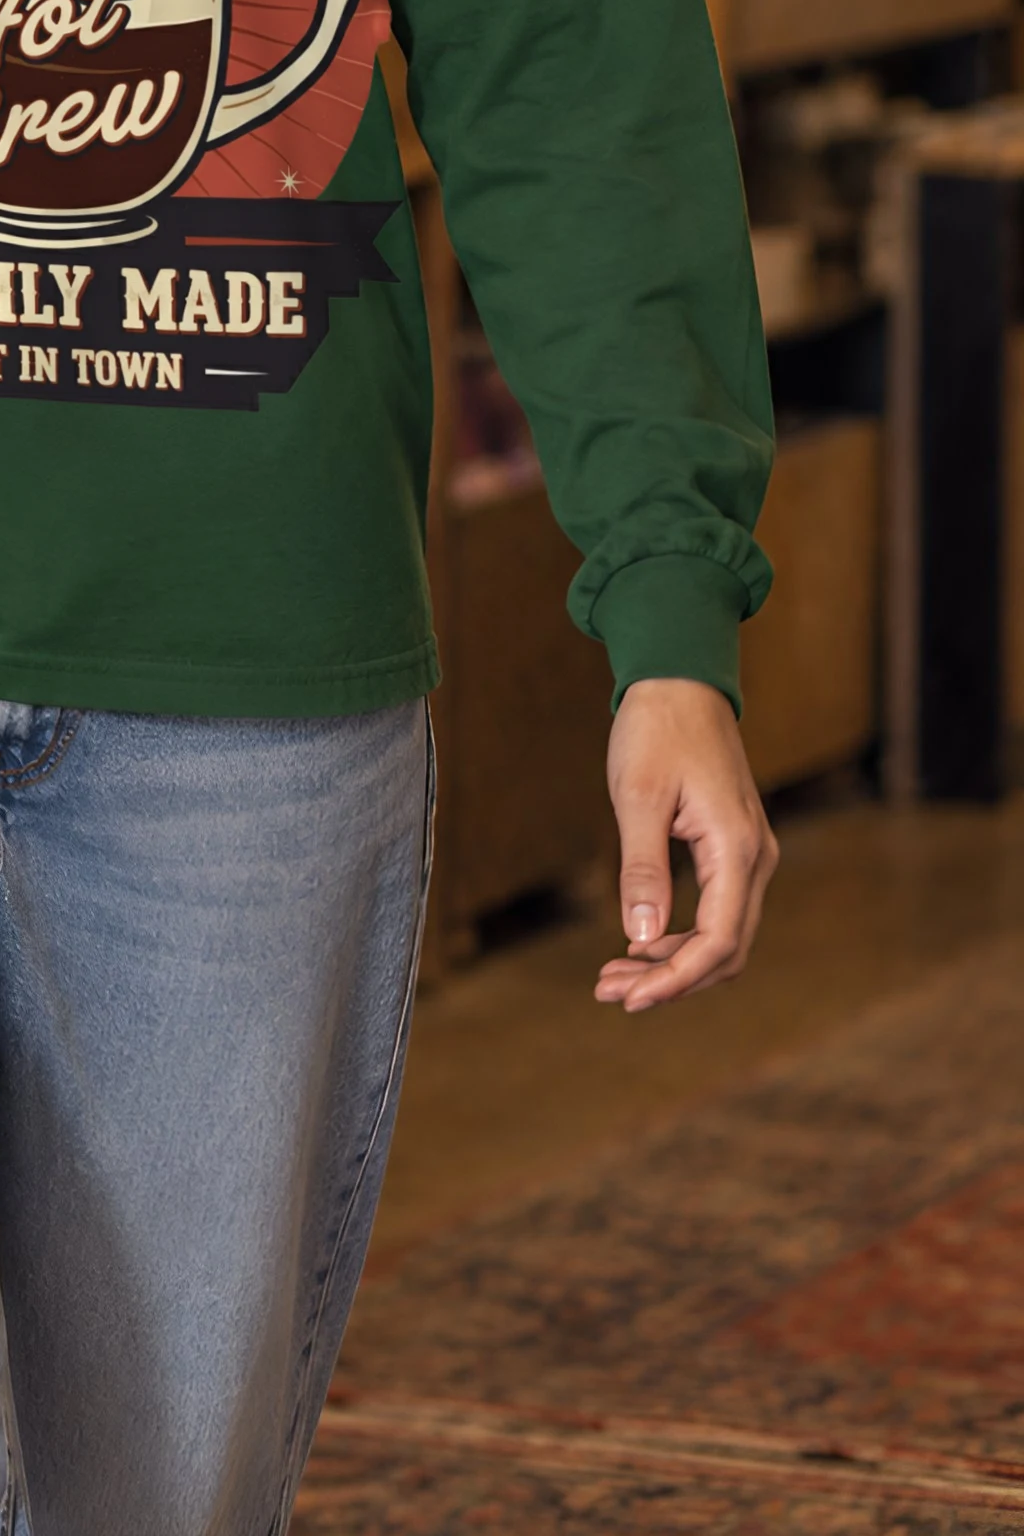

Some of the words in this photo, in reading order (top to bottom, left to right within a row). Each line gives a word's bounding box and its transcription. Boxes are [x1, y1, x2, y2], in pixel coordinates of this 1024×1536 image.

[121, 268, 307, 337] MADE
[19, 345, 57, 383] IN
[72, 349, 182, 390] TOWN
